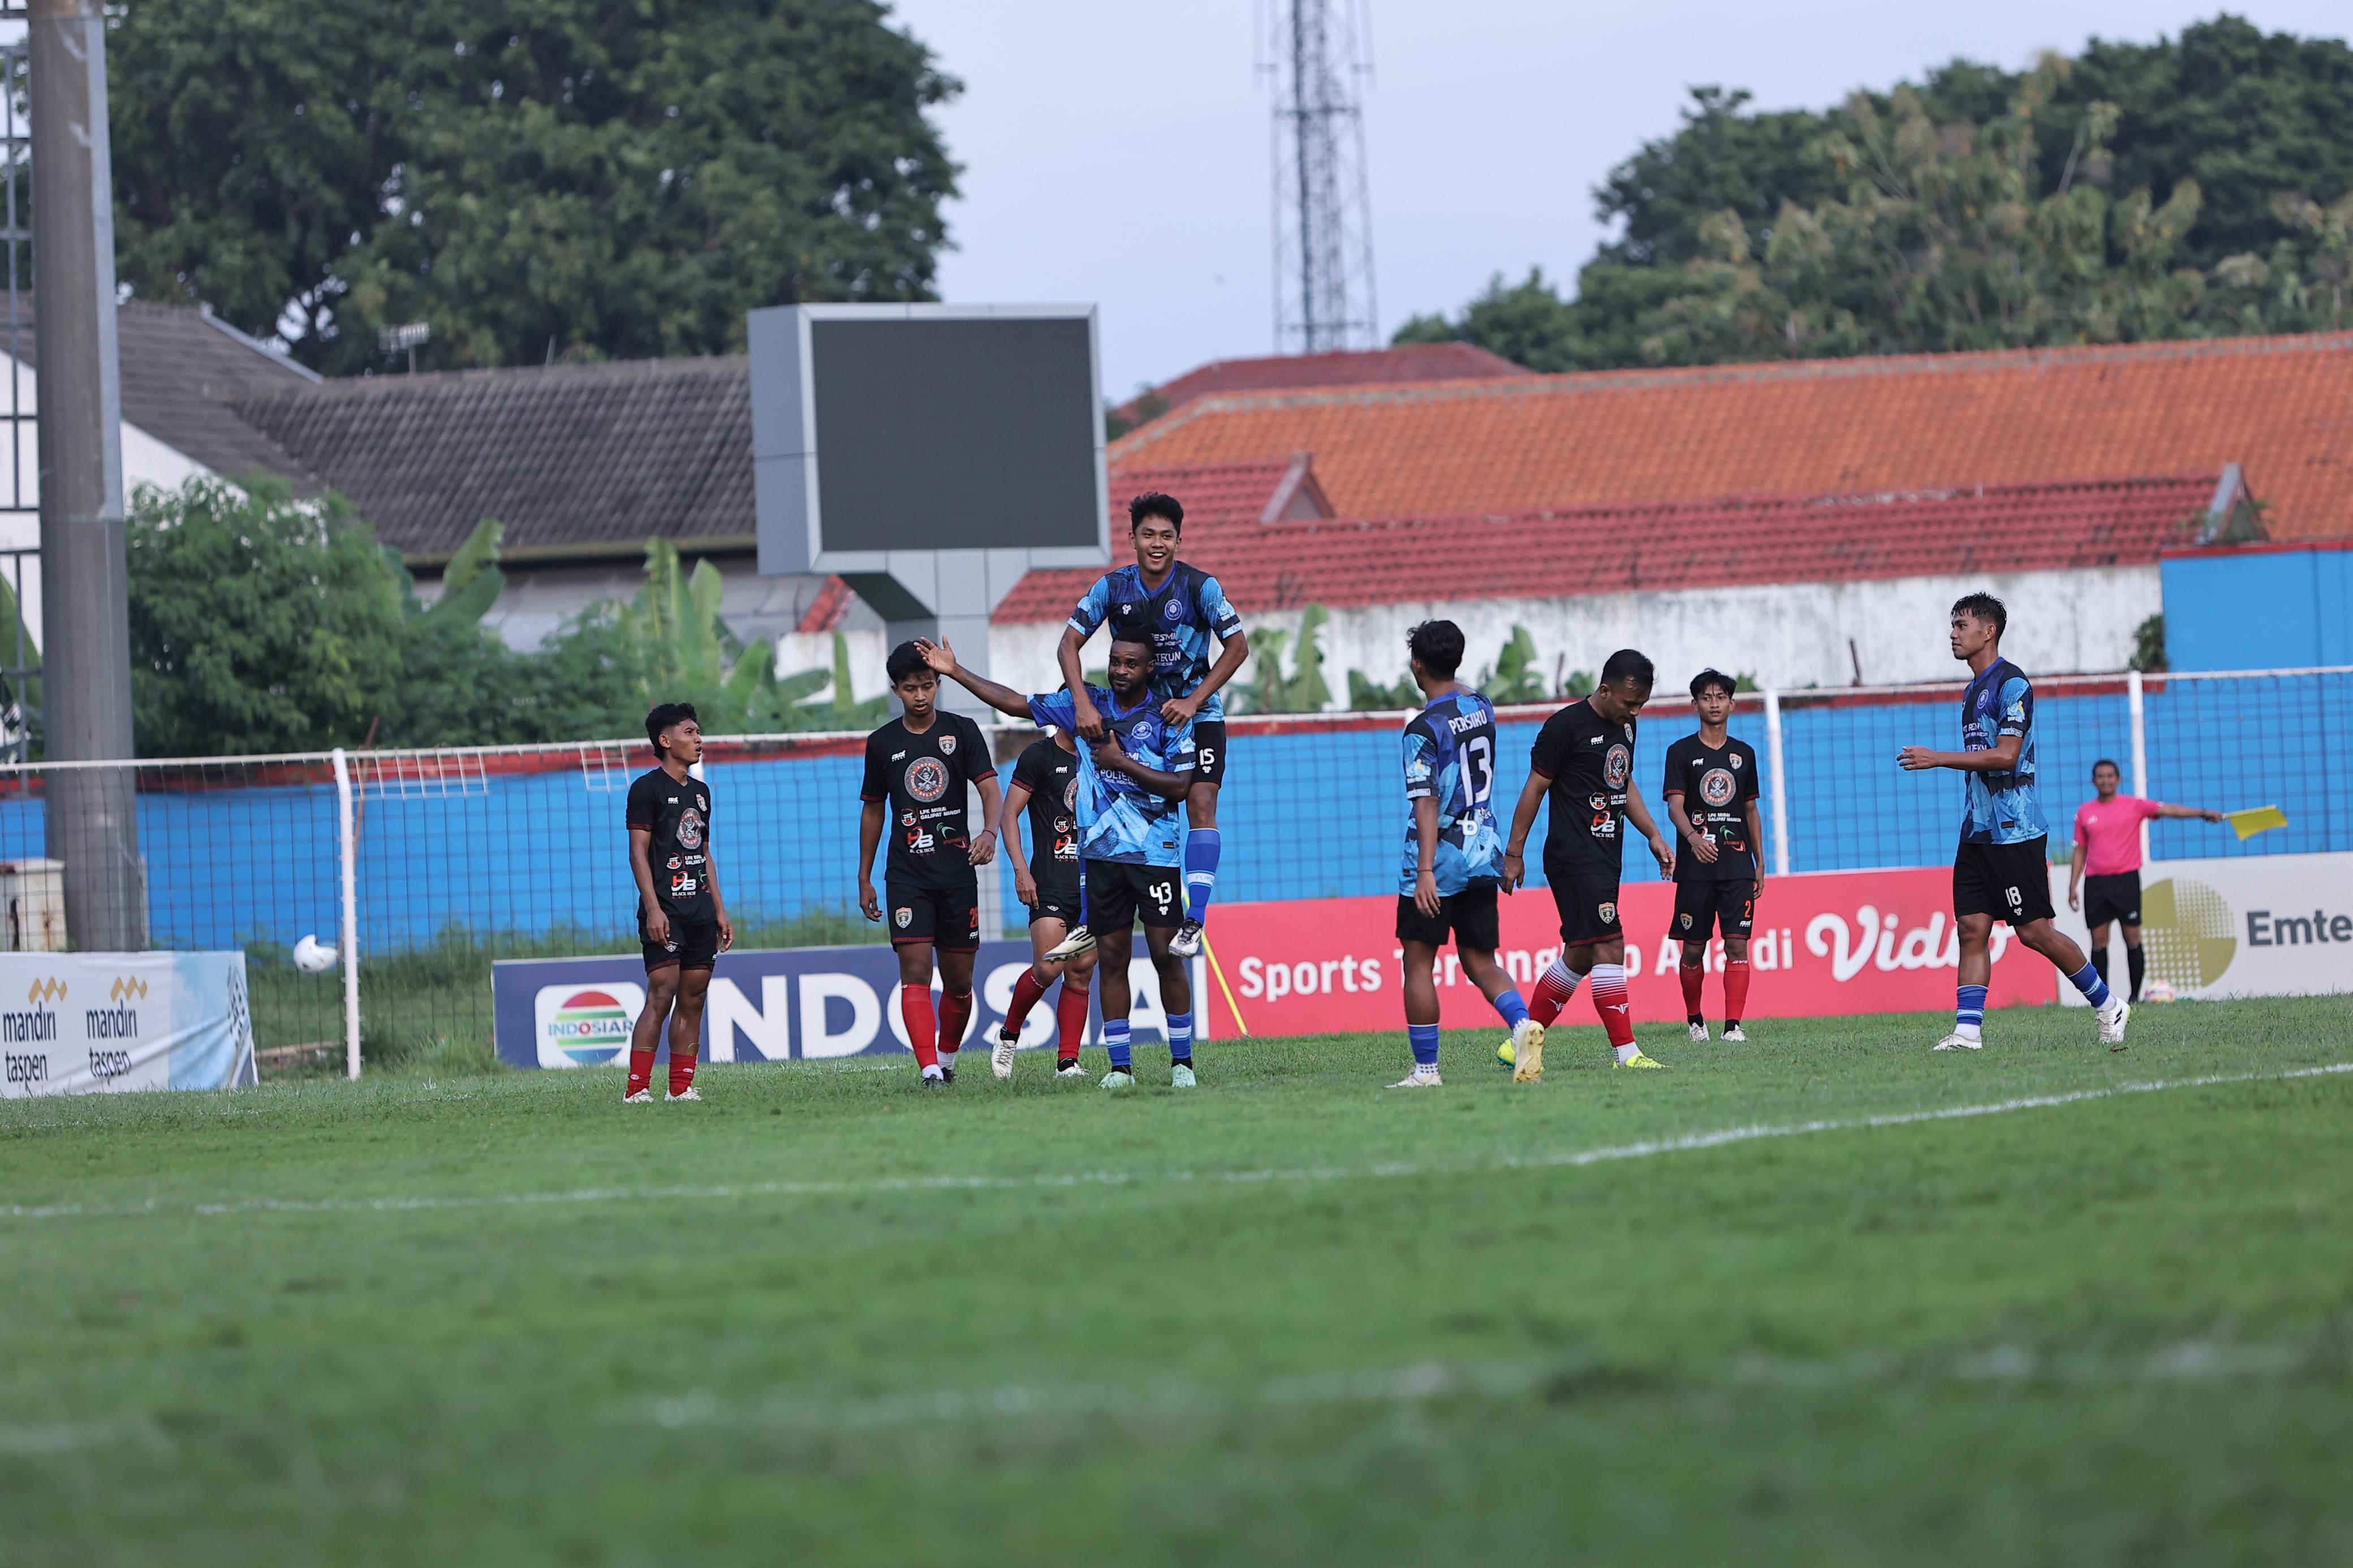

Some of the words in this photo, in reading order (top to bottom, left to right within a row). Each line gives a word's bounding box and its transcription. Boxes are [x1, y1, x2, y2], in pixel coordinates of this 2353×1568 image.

[1449, 709, 1488, 735] PERSIKU
[1199, 748, 1215, 765] 15
[1459, 735, 1493, 808] 13
[1149, 881, 1173, 904] 43
[2005, 886, 2022, 907] 18
[1744, 900, 1751, 917] 2
[1239, 954, 1382, 1002] Sports
[2, 1001, 57, 1043] mandiri
[86, 998, 137, 1040] mandiri
[548, 1019, 634, 1037] INDOSIAR
[5, 1050, 48, 1088] taspen
[89, 1047, 132, 1084] taspen
